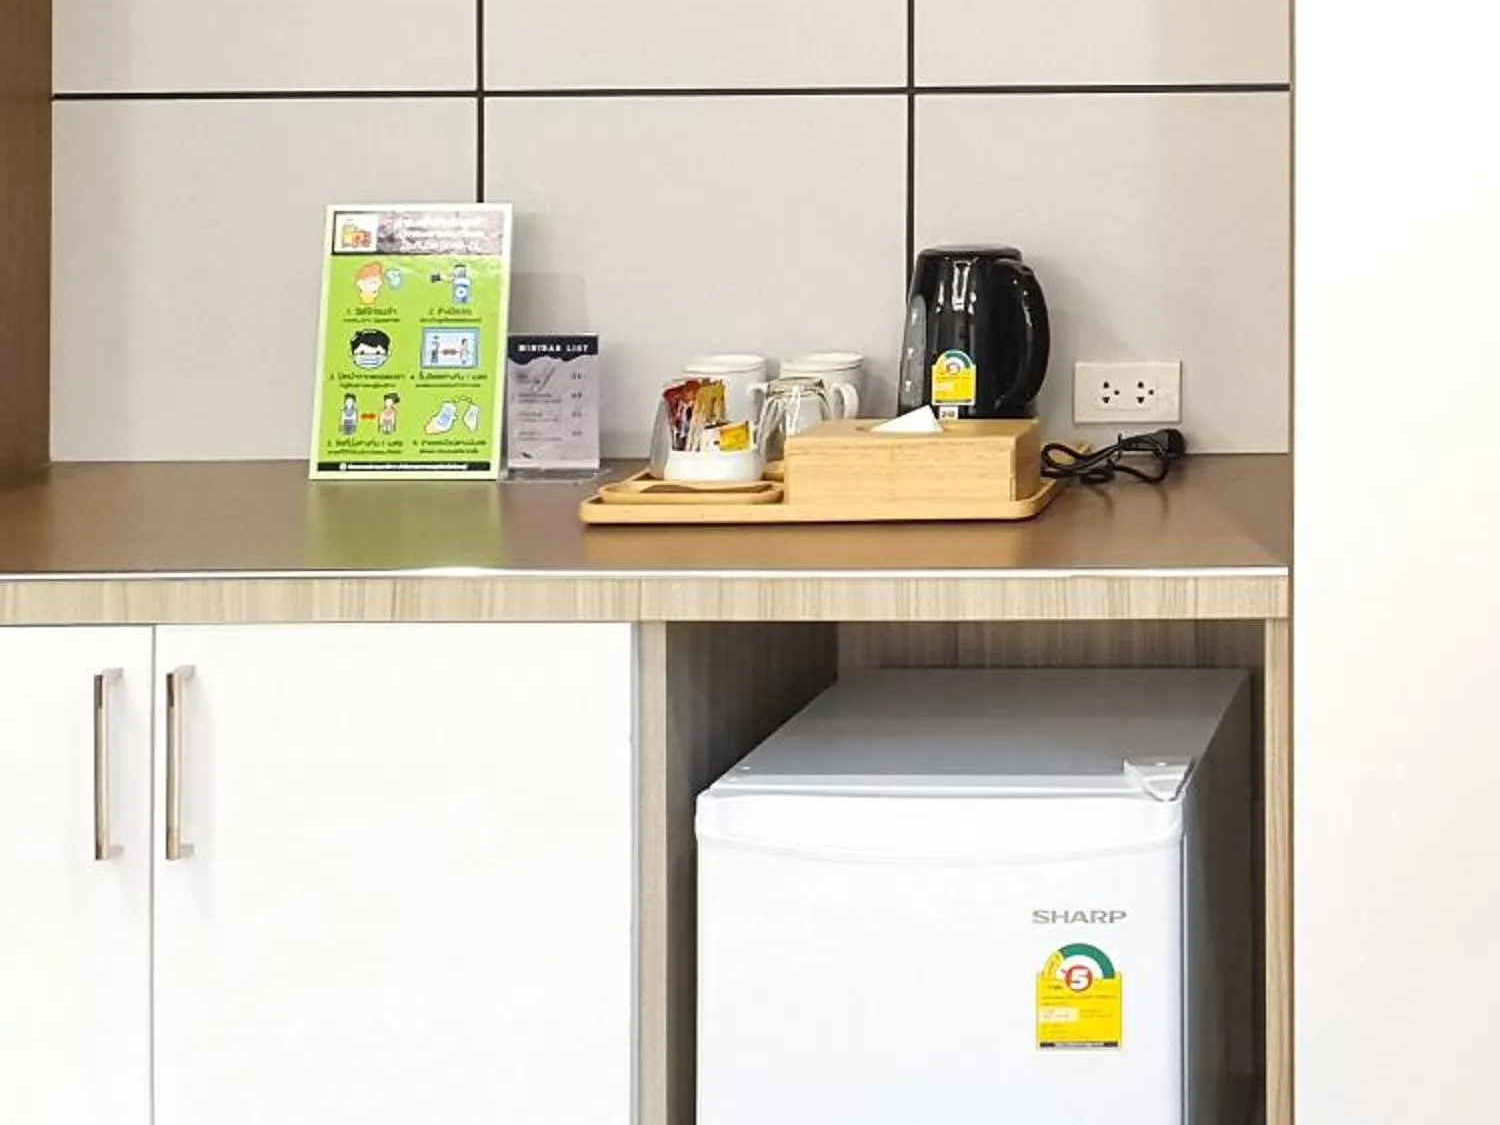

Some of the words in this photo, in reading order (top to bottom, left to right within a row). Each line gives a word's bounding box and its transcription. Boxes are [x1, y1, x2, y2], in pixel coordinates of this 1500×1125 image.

[518, 344, 561, 352] MINIBAR
[566, 344, 588, 352] LIST
[1032, 909, 1128, 924] SHARP
[1069, 967, 1090, 990] 5
